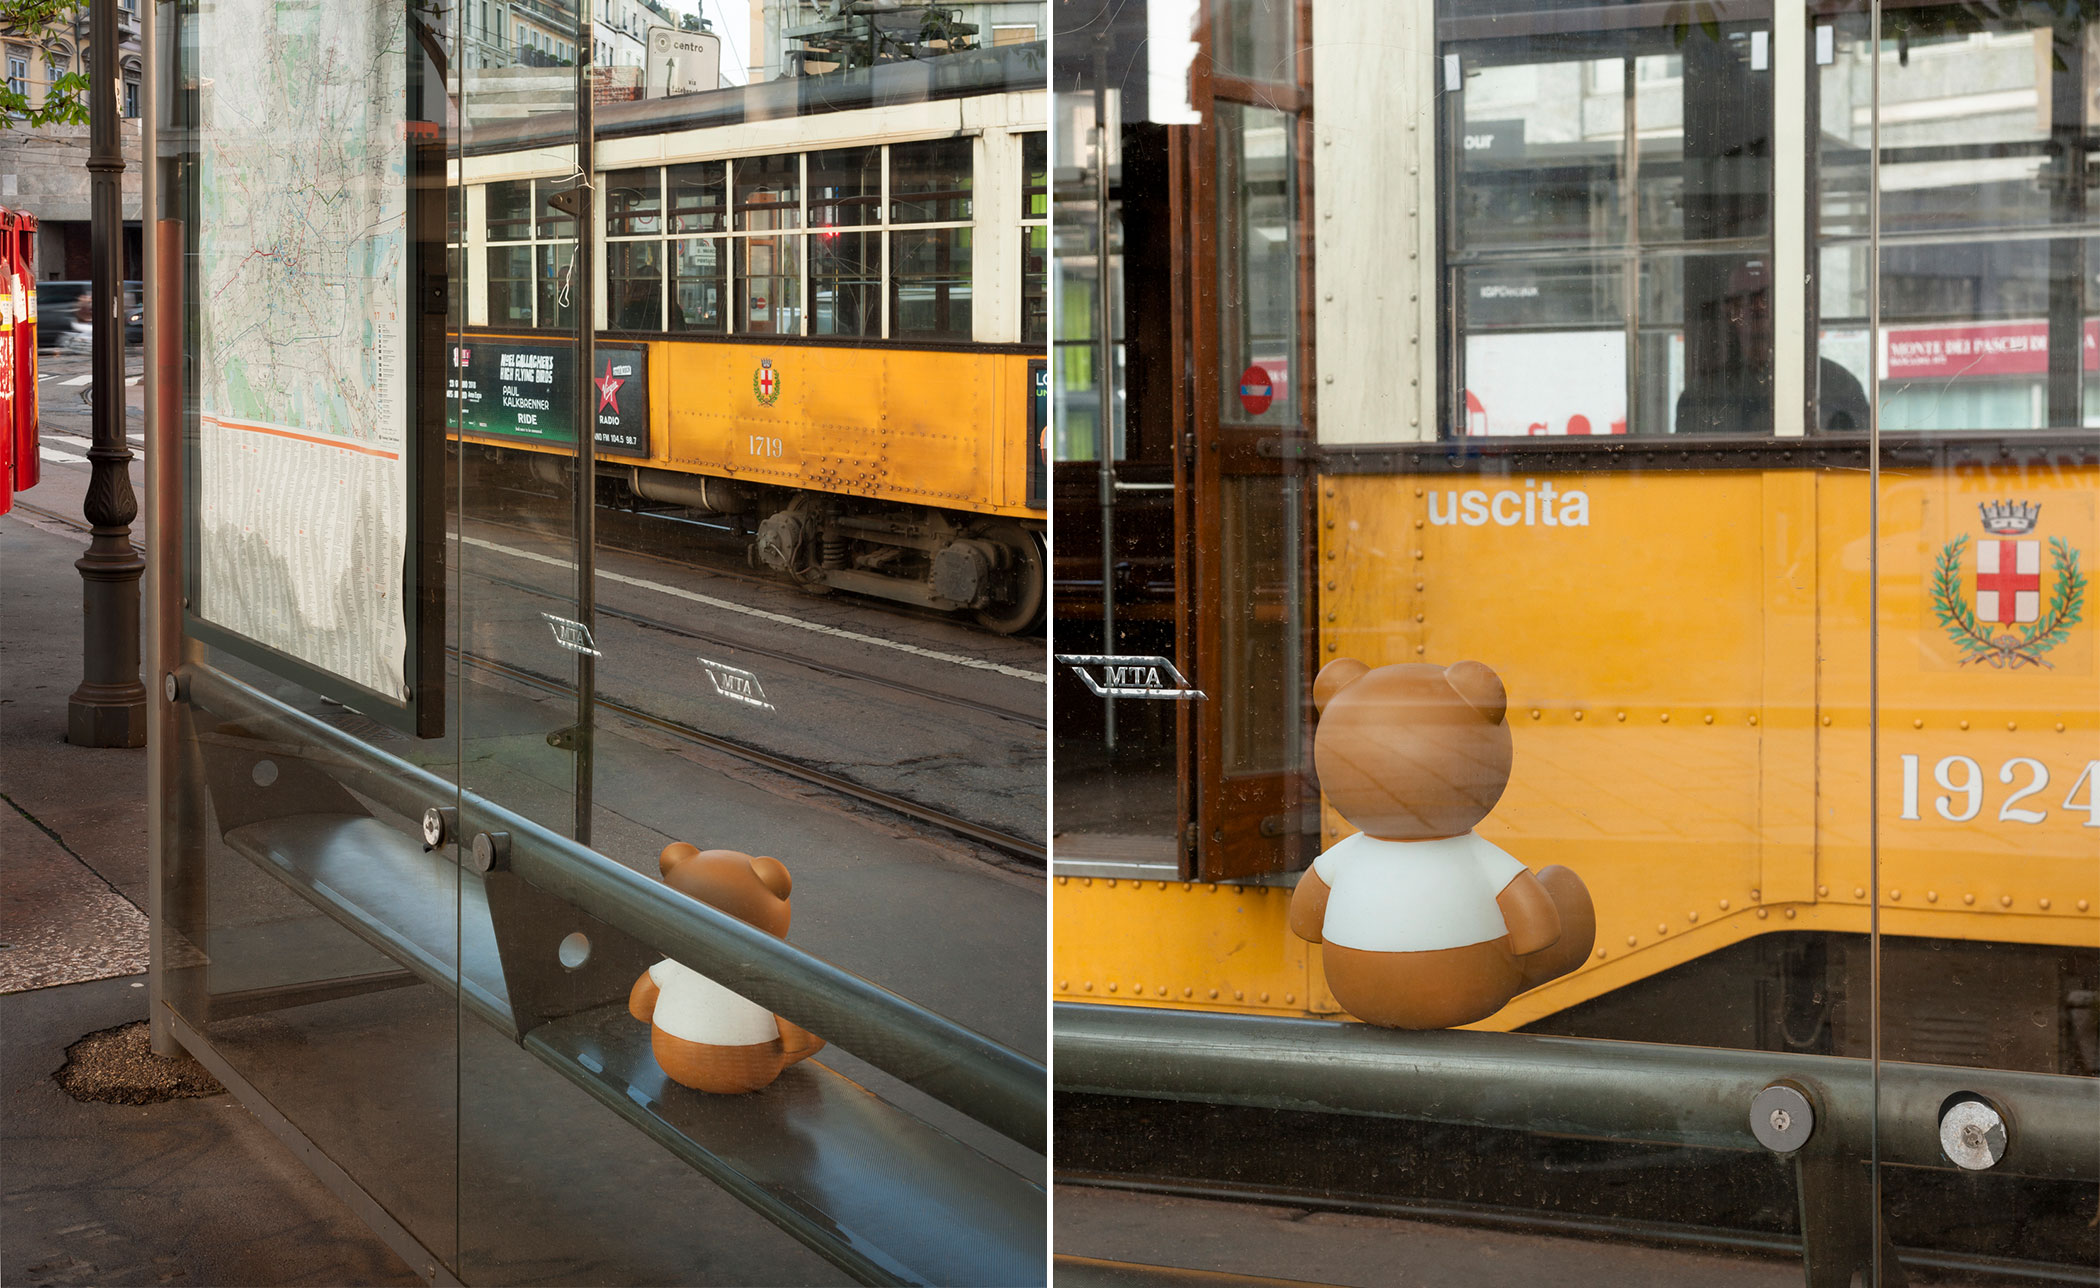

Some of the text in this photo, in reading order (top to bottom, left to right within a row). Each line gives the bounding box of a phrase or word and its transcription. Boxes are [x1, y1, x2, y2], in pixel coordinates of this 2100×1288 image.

[674, 41, 704, 53] centro
[1890, 339, 1944, 355] MONTE
[515, 368, 534, 383] FLYING
[503, 386, 520, 397] PAUL
[503, 397, 550, 411] KALKBRENNER
[518, 413, 538, 425] RIDE
[599, 415, 620, 426] RADIO
[611, 434, 624, 444] 104.5
[625, 436, 637, 445] 98.7
[749, 434, 783, 458] 1719
[1428, 478, 1589, 526] uscita
[560, 624, 584, 646] MTA
[722, 672, 752, 697] MTA
[1104, 666, 1163, 688] MTA
[1900, 754, 2100, 828] 1924
